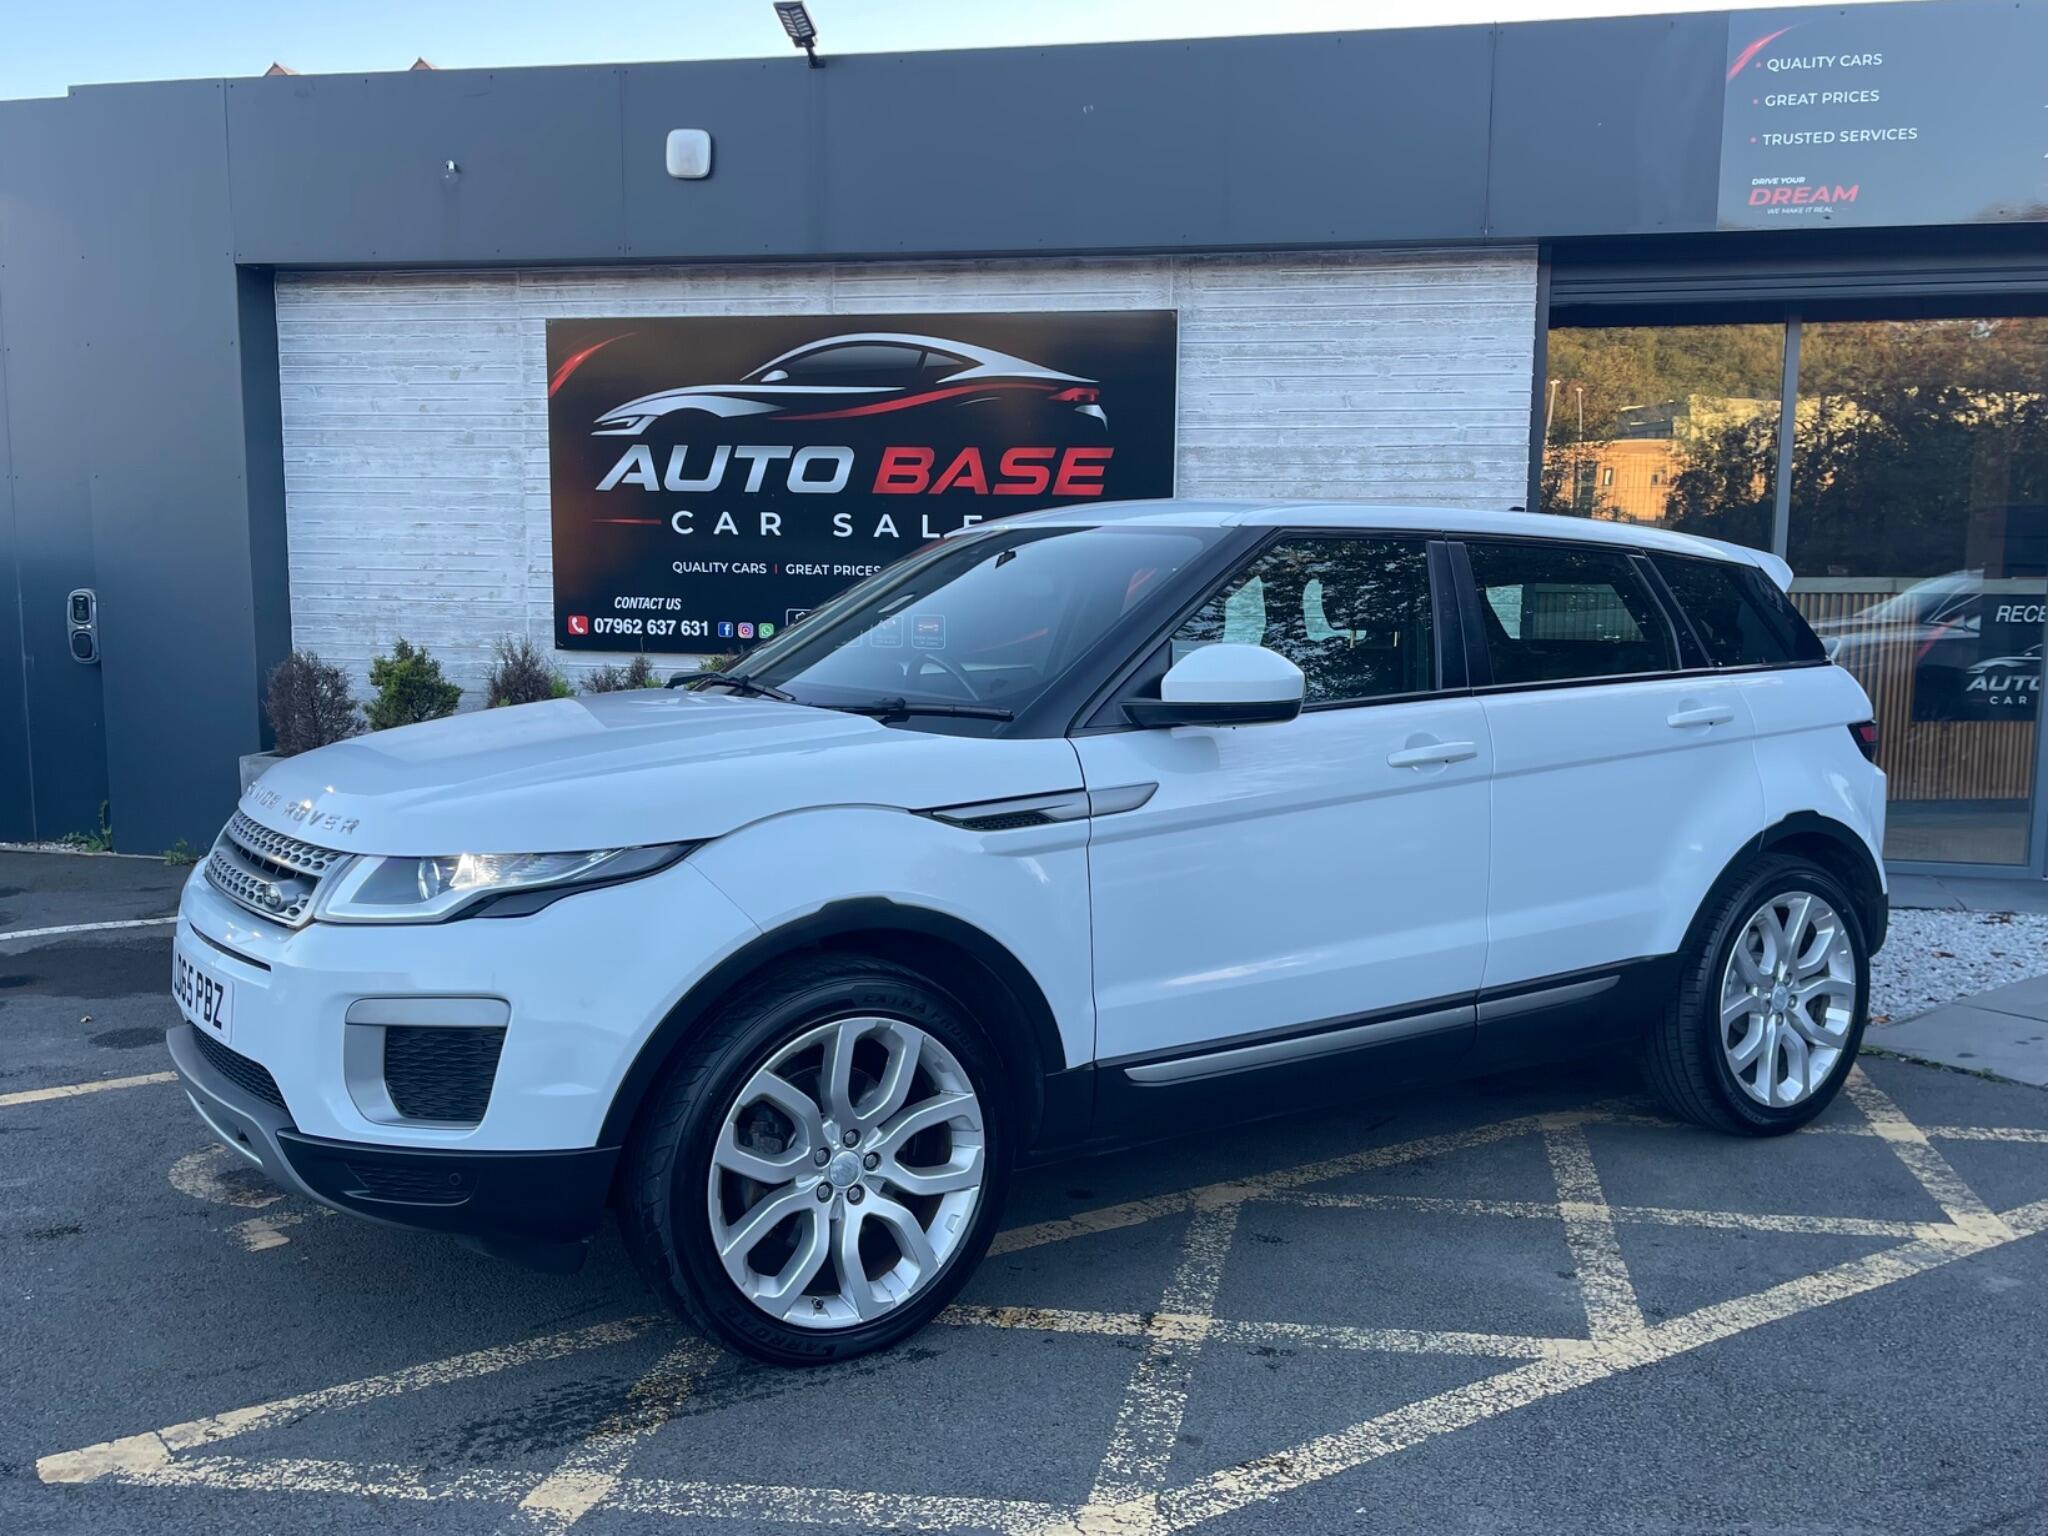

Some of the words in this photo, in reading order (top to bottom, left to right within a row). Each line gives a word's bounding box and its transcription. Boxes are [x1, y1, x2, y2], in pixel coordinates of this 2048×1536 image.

[1766, 55, 1836, 72] QUALITY
[1839, 53, 1883, 67] CARS
[1764, 92, 1818, 107] GREAT
[1821, 89, 1880, 104] PRICES
[1762, 131, 1836, 146] TRUSTED
[1839, 127, 1918, 142] SERVICES
[1751, 177, 1779, 186] DRIVE
[1781, 176, 1806, 185] YOUR
[1748, 184, 1860, 206] DREAM
[595, 444, 856, 494] AUTO
[871, 446, 1115, 496] BASE
[670, 510, 783, 537] CAR
[672, 561, 729, 575] QUALITY
[731, 562, 768, 575] CARS
[785, 563, 830, 576] GREAT
[614, 596, 664, 610] CONTACT
[665, 597, 682, 611] US
[594, 617, 643, 635] 07962
[646, 619, 676, 636] 637
[680, 620, 709, 637] 631
[1989, 695, 2028, 705] CAR
[281, 799, 361, 835] ROVER
[195, 970, 225, 1031] PBZ
